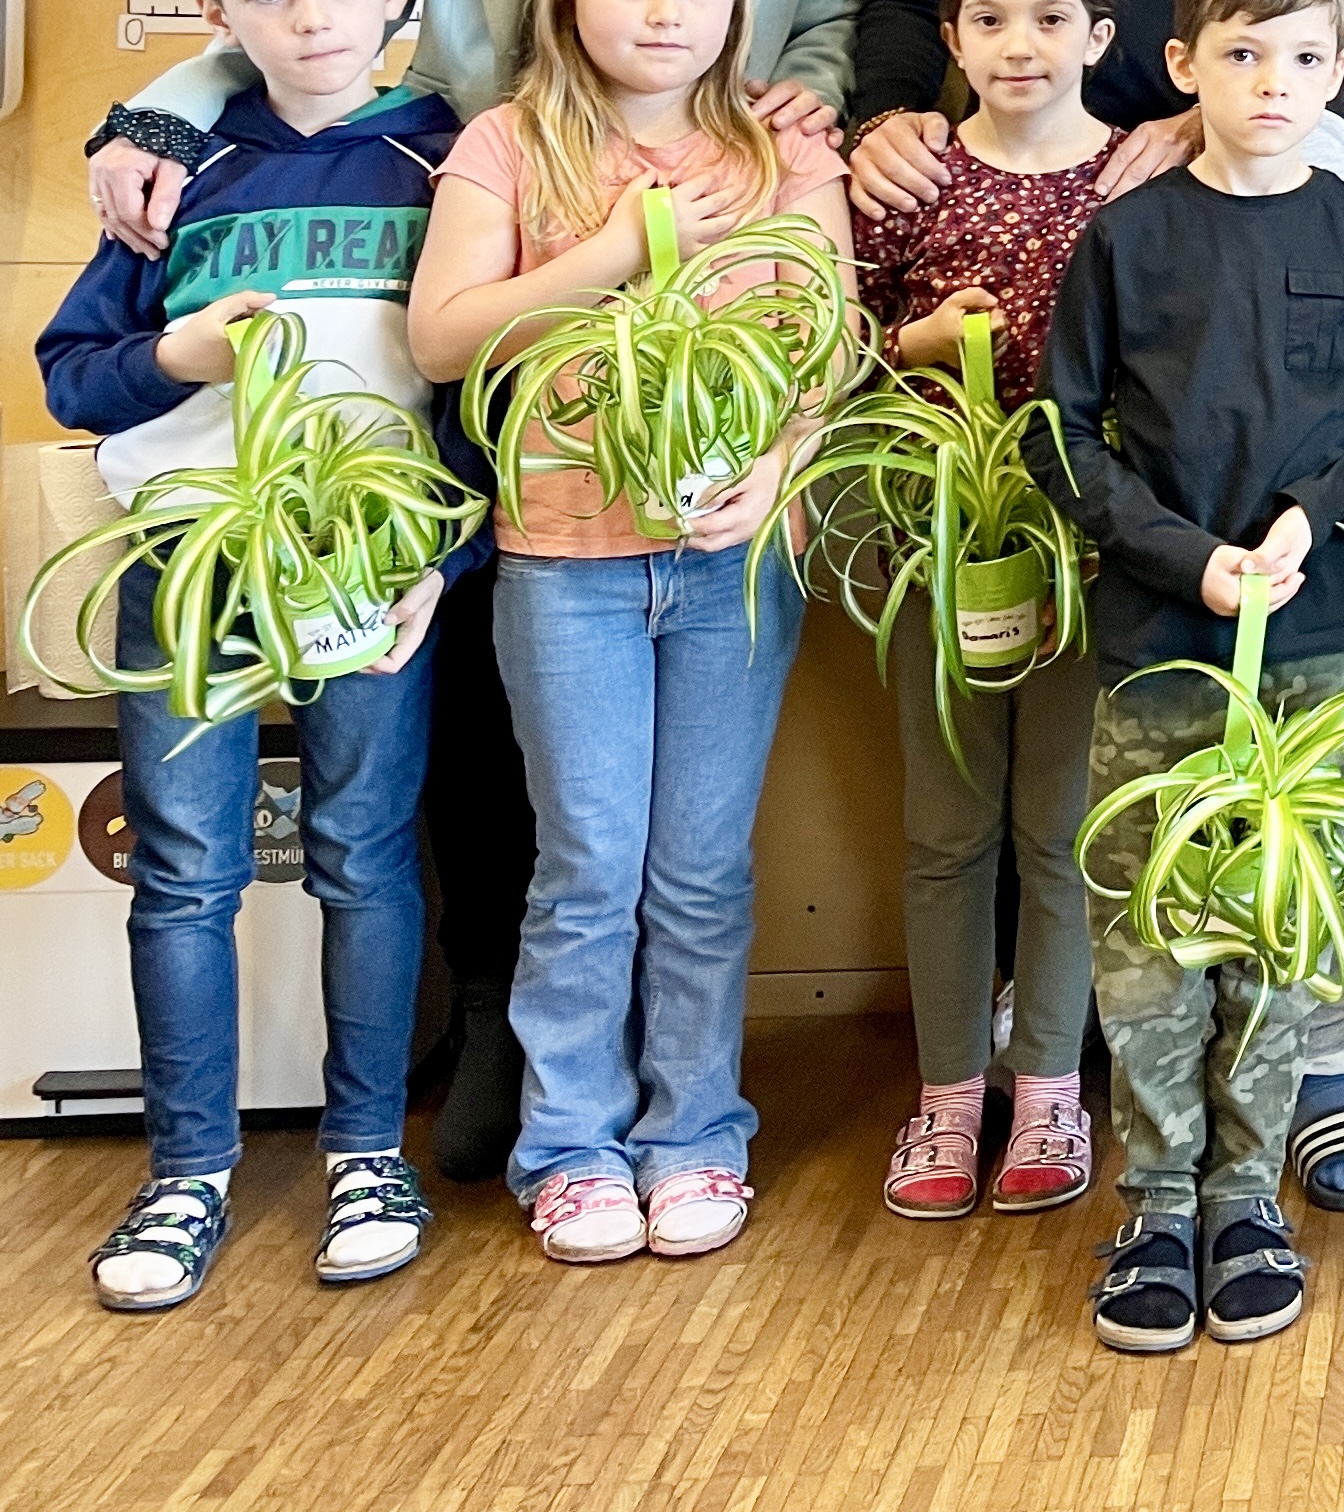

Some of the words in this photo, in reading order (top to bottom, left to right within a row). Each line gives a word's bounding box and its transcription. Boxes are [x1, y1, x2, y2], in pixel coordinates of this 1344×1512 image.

[312, 279, 351, 288] NEVER
[358, 279, 390, 289] GIVE
[19, 850, 57, 868] SACK
